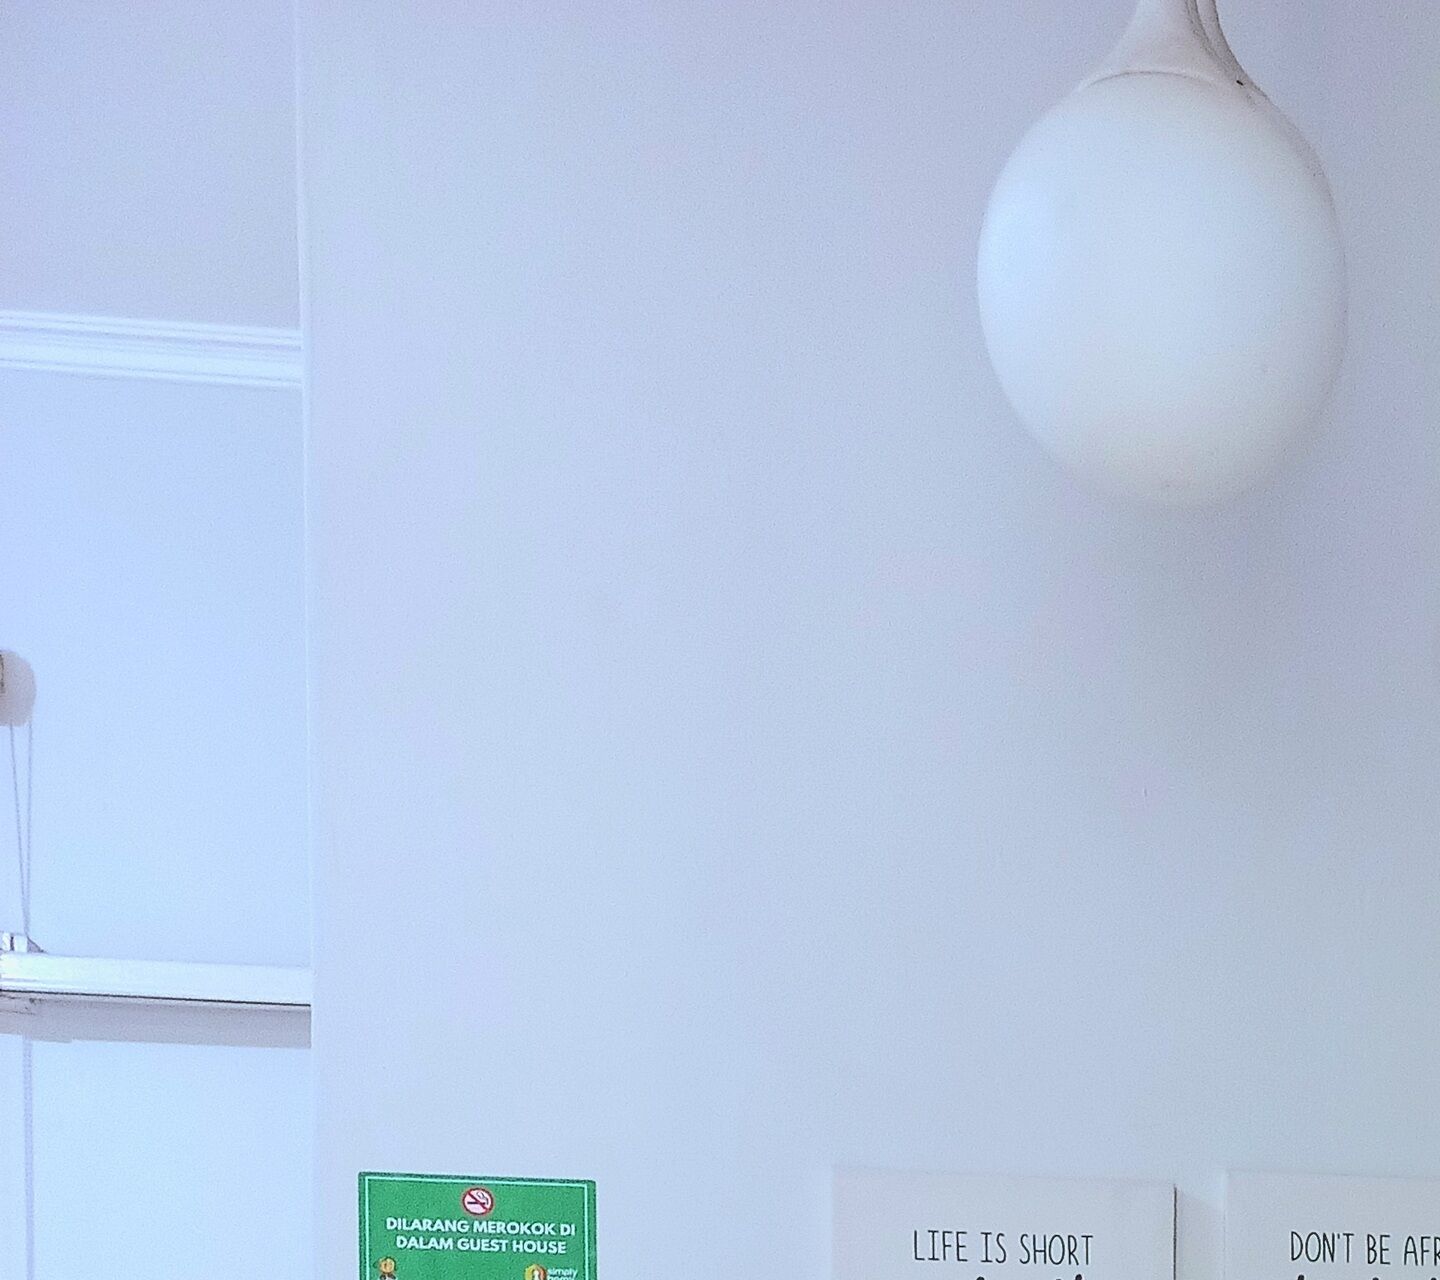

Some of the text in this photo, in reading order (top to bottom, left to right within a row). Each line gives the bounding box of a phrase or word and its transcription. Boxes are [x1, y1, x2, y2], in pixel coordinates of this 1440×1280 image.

[386, 1217, 576, 1236] DILARANG MEROKOK DI
[396, 1235, 567, 1254] DALAM GUEST HOUSE
[913, 1230, 1094, 1266] LIFE IS SHORT
[1290, 1231, 1355, 1263] DON'T
[1366, 1234, 1392, 1266] BE
